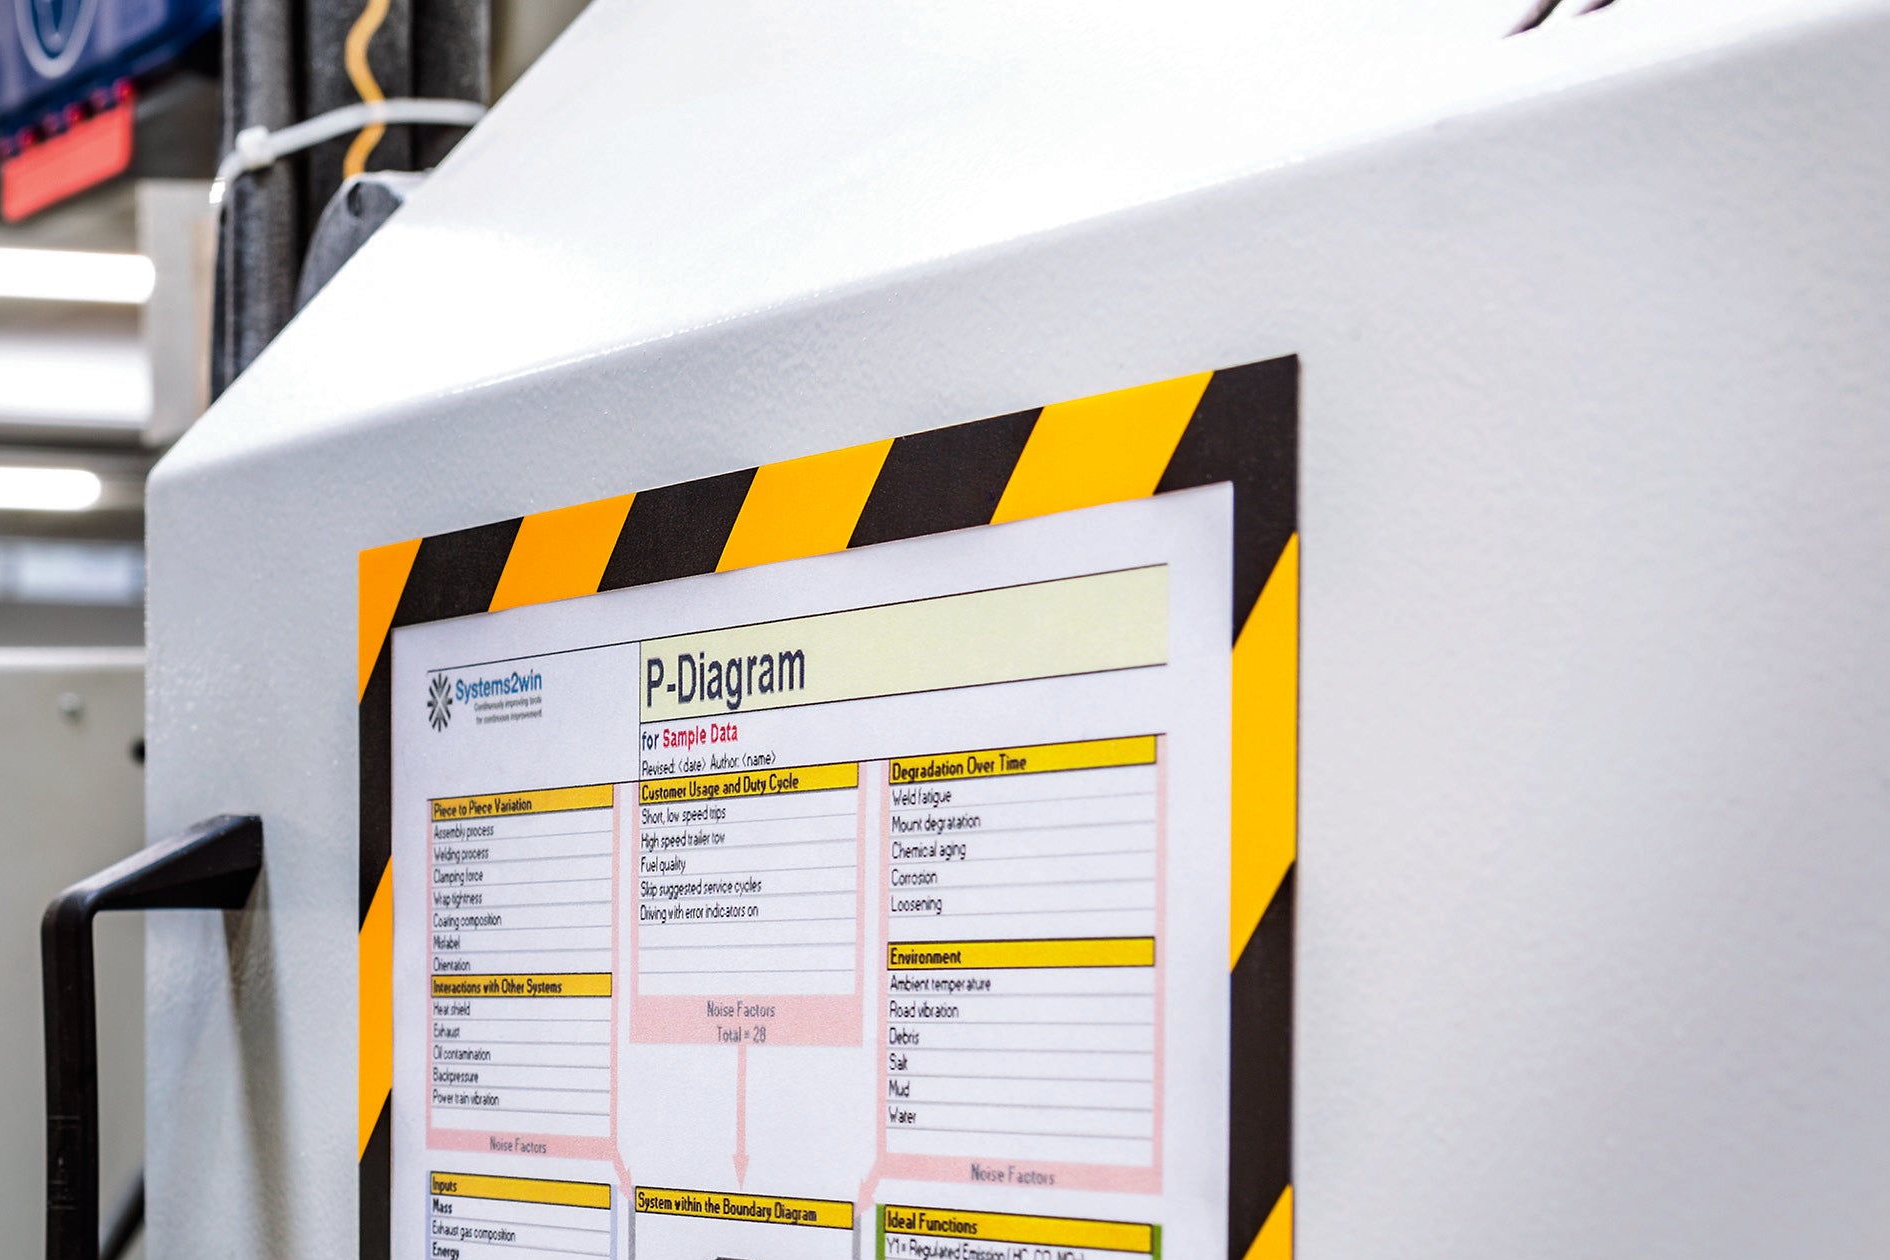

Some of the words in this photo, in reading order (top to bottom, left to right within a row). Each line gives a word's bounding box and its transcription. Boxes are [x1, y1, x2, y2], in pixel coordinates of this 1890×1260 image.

[456, 669, 542, 704] Systems2win
[647, 649, 805, 710] P-Diagram
[642, 732, 659, 749] for
[663, 725, 706, 751] Sample
[711, 723, 738, 743] Data
[642, 760, 675, 776] Revised:
[679, 759, 706, 773] <date>
[710, 754, 738, 770] Author:
[742, 751, 776, 768] <name>
[893, 761, 963, 783] Degradation
[968, 756, 994, 774] Over
[1000, 754, 1026, 770] Time
[642, 784, 686, 800] Customer
[689, 778, 719, 800] Usage
[723, 779, 740, 795] and
[744, 776, 766, 794] Duty
[770, 773, 798, 791] Cycle
[918, 788, 951, 807] fatigue
[434, 804, 456, 817] Piece
[469, 800, 492, 814] Piece
[495, 798, 532, 812] Variation
[642, 808, 665, 824] Short,
[667, 810, 679, 822] low
[682, 808, 708, 825] speed
[434, 824, 465, 839] Assembly
[467, 825, 494, 841] process
[892, 815, 922, 832] Mount
[641, 833, 659, 852] High
[661, 833, 686, 850] speed
[688, 831, 710, 845] trailer
[892, 841, 937, 859] Chemical
[939, 842, 966, 860] aging
[641, 857, 658, 872] Fuel
[660, 856, 686, 875] quality
[892, 868, 937, 886] Corrosion
[641, 881, 657, 898] Skip
[660, 879, 701, 899] suggested
[704, 880, 732, 893] service
[734, 877, 761, 896] cycles
[641, 906, 666, 923] Driving
[686, 907, 704, 919] error
[705, 904, 745, 918] indicators
[747, 906, 758, 917] on
[891, 897, 942, 914] Loosening
[890, 948, 961, 965] Environment
[434, 980, 481, 994] Interactions
[484, 980, 499, 993] with
[502, 979, 523, 993] Other
[527, 978, 562, 996] Systems
[890, 975, 929, 991] Ambient
[931, 977, 991, 994] temperature
[707, 1001, 734, 1017] Noise
[737, 1001, 775, 1017] Factors
[890, 1000, 915, 1018] Road
[717, 1026, 741, 1042] Total
[753, 1027, 766, 1043] 28
[889, 1028, 919, 1044] Debris
[889, 1080, 910, 1097] Mud
[889, 1107, 916, 1124] Water
[490, 1136, 512, 1151] Noise
[515, 1138, 546, 1153] Factors
[971, 1164, 1004, 1182] Noise
[1009, 1166, 1055, 1185] Factors
[432, 1176, 457, 1194] Inputs
[432, 1199, 452, 1214] Mass
[638, 1192, 672, 1211] System
[675, 1197, 702, 1213] within
[705, 1198, 719, 1213] the
[723, 1199, 771, 1220] Boundary
[775, 1202, 817, 1224] Diagram
[888, 1211, 916, 1229] Ideal
[919, 1213, 977, 1235] Functions
[432, 1242, 459, 1260] Energy
[910, 1239, 960, 1260] Regulated
